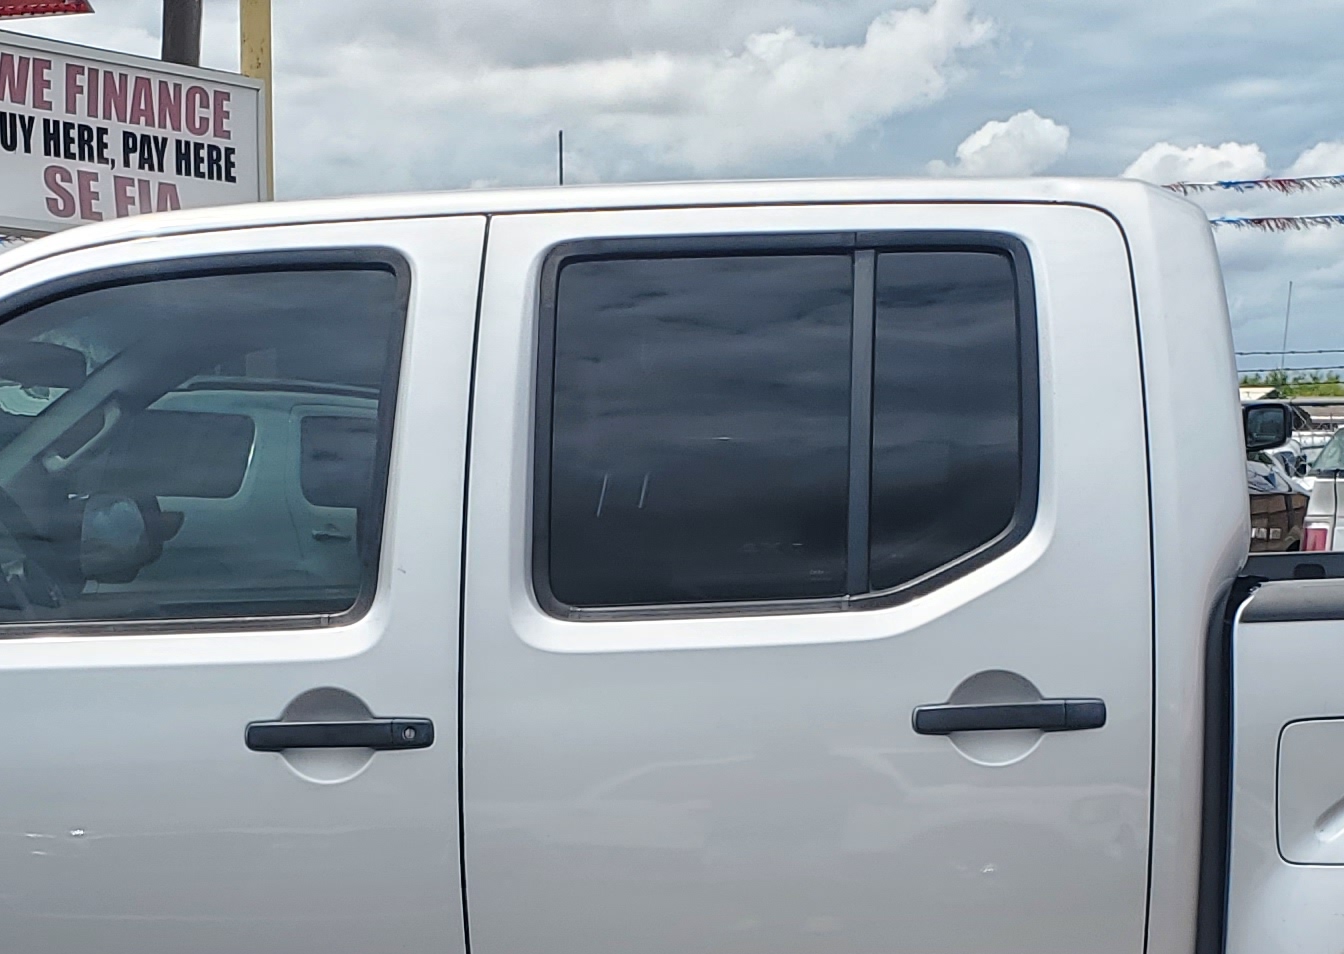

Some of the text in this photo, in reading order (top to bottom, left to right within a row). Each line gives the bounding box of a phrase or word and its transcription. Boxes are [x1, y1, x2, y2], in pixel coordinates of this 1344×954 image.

[65, 63, 231, 140] FINANCE
[43, 118, 116, 171] HERE,
[122, 130, 168, 174] PAY
[175, 139, 237, 184] HERE
[43, 165, 103, 222] SE
